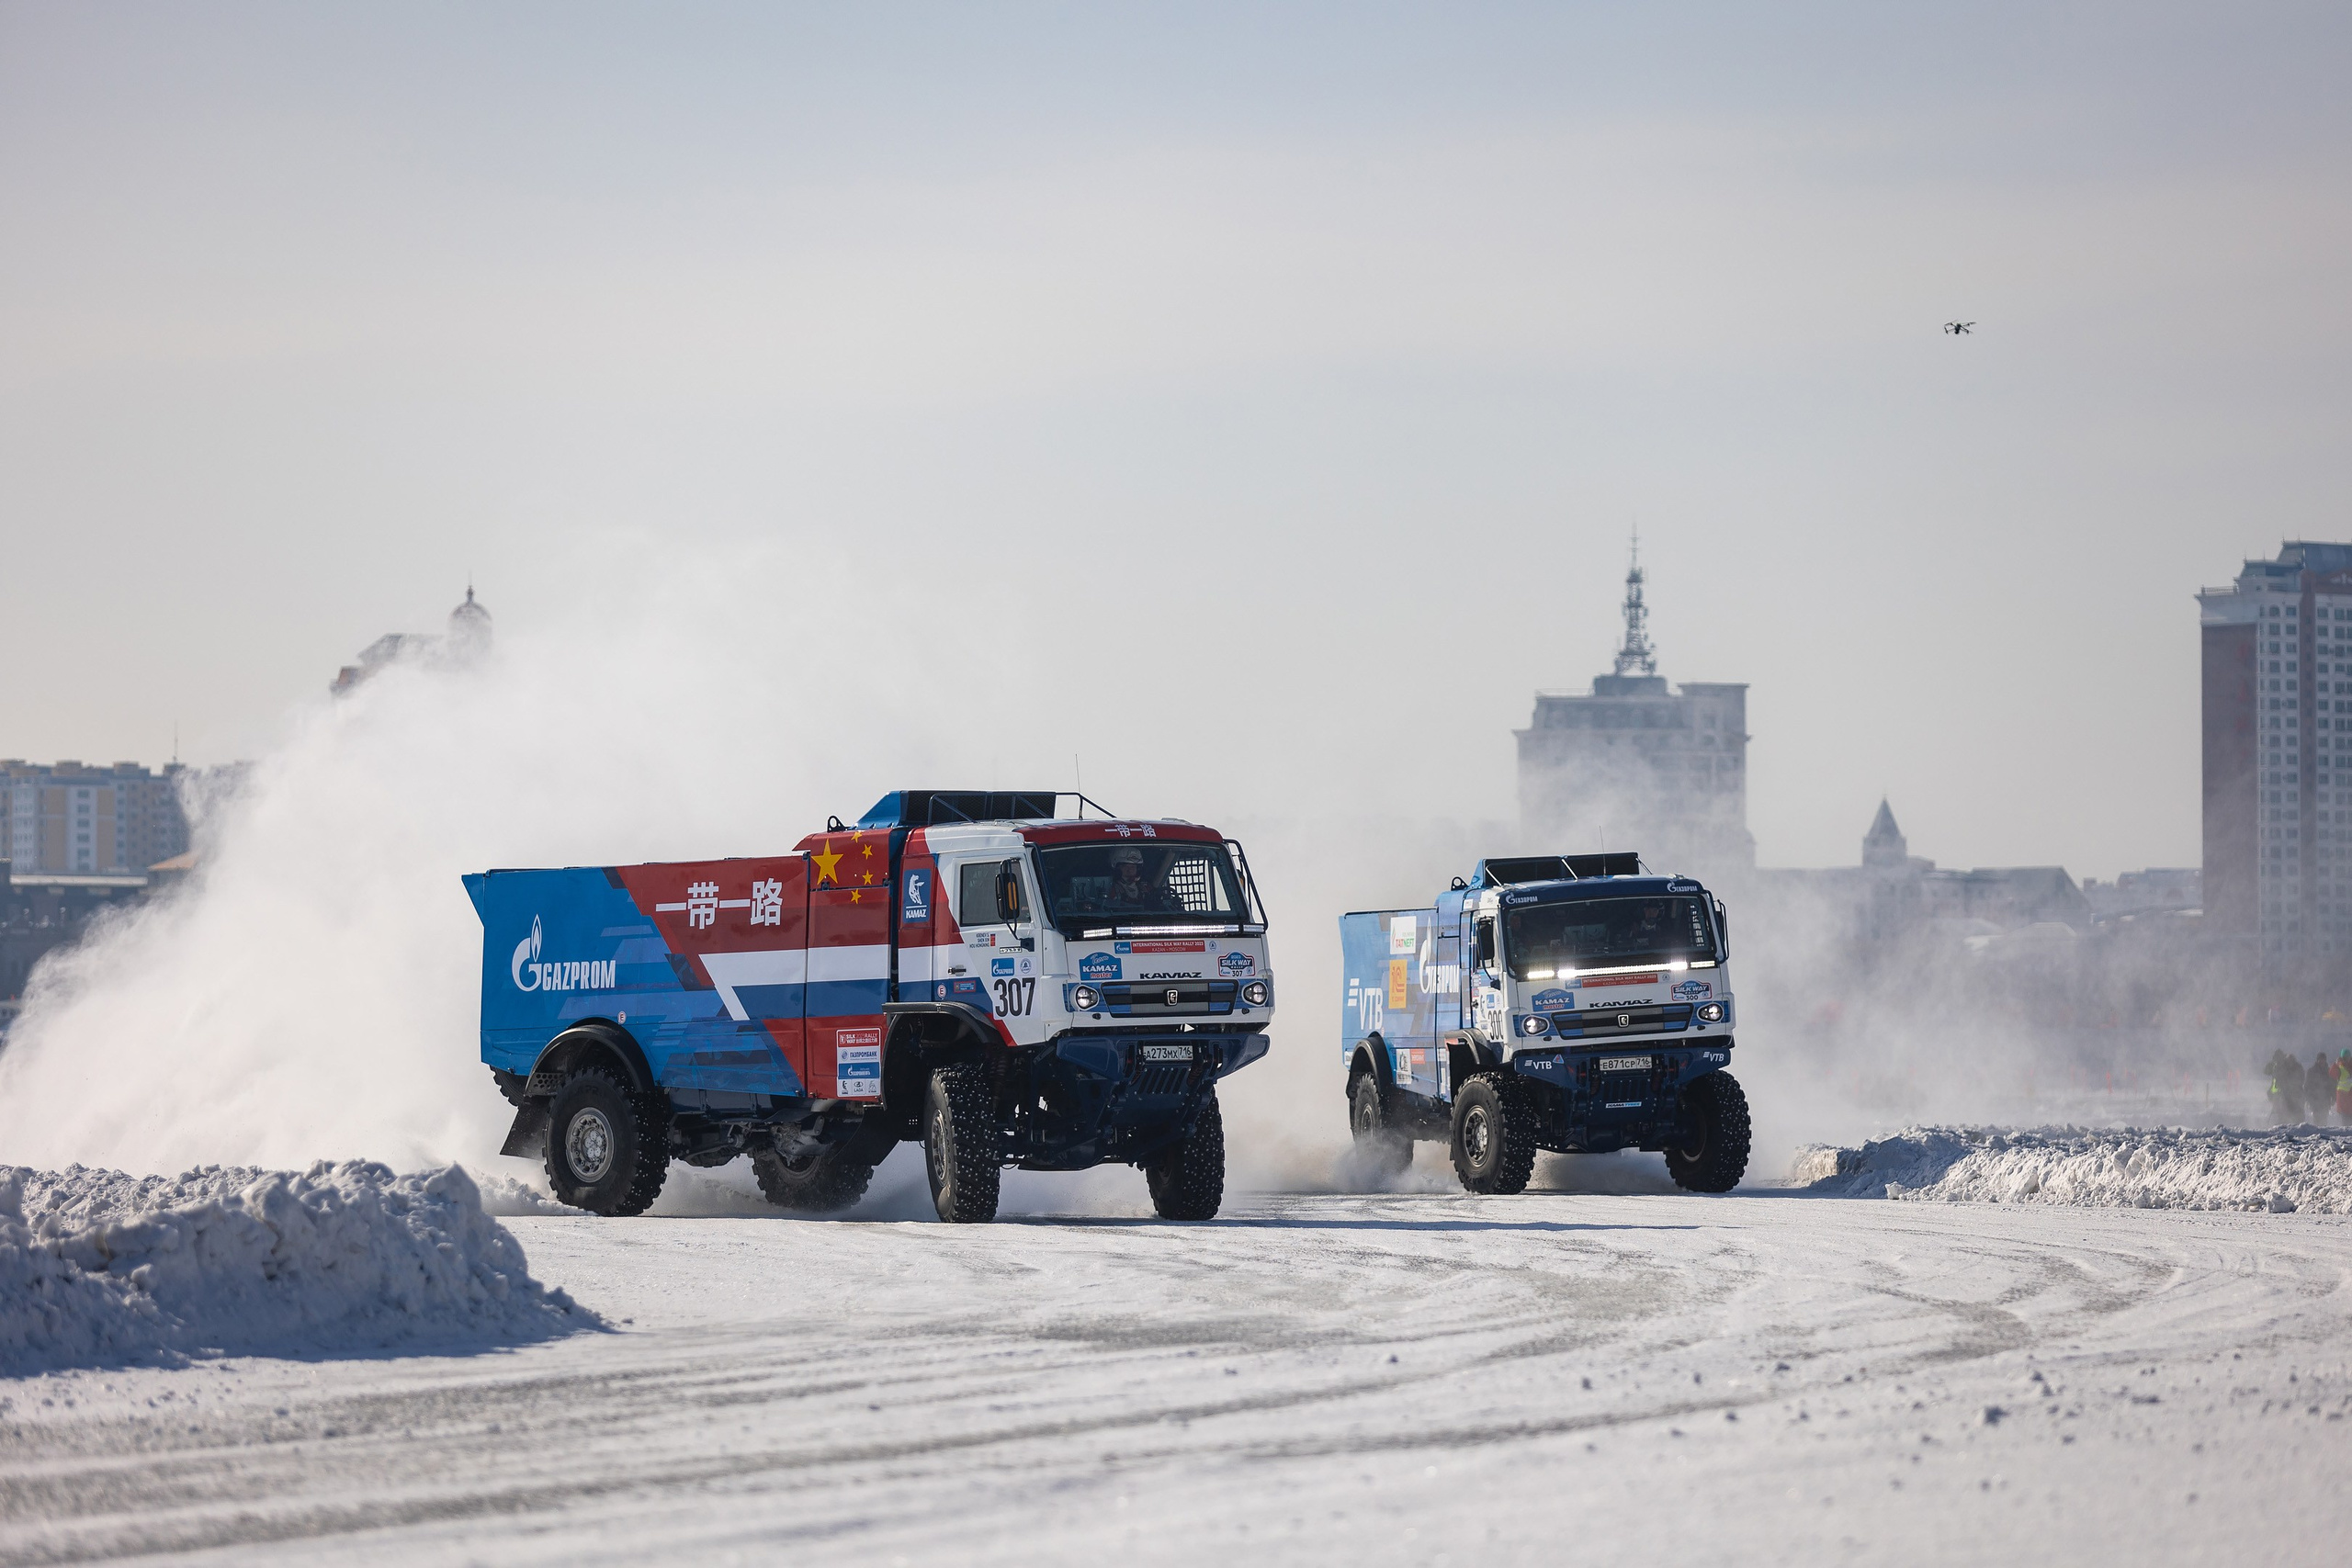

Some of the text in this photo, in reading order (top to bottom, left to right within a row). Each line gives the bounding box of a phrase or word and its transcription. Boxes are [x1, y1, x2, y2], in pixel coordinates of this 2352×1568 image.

[1104, 824, 1156, 837] 一带一路
[655, 878, 784, 930] 一带一路
[906, 908, 927, 919] KAMAZ
[1396, 938, 1415, 948] TATNEFT
[1082, 964, 1118, 973] KAMAZ
[542, 960, 616, 991] GAZPROM
[1139, 972, 1202, 980] KAMAZ
[993, 977, 1035, 1017] 307
[1534, 998, 1570, 1006] KAMAZ
[1360, 987, 1384, 1030] VTB
[1589, 998, 1654, 1009] KAMAZ
[850, 1050, 877, 1058] ГАЗПРОМБАНК
[1146, 1046, 1193, 1059] А273МХ 716
[1710, 1054, 1724, 1062] VTB
[1532, 1061, 1552, 1070] VTB
[1602, 1059, 1635, 1069] Е871СР
